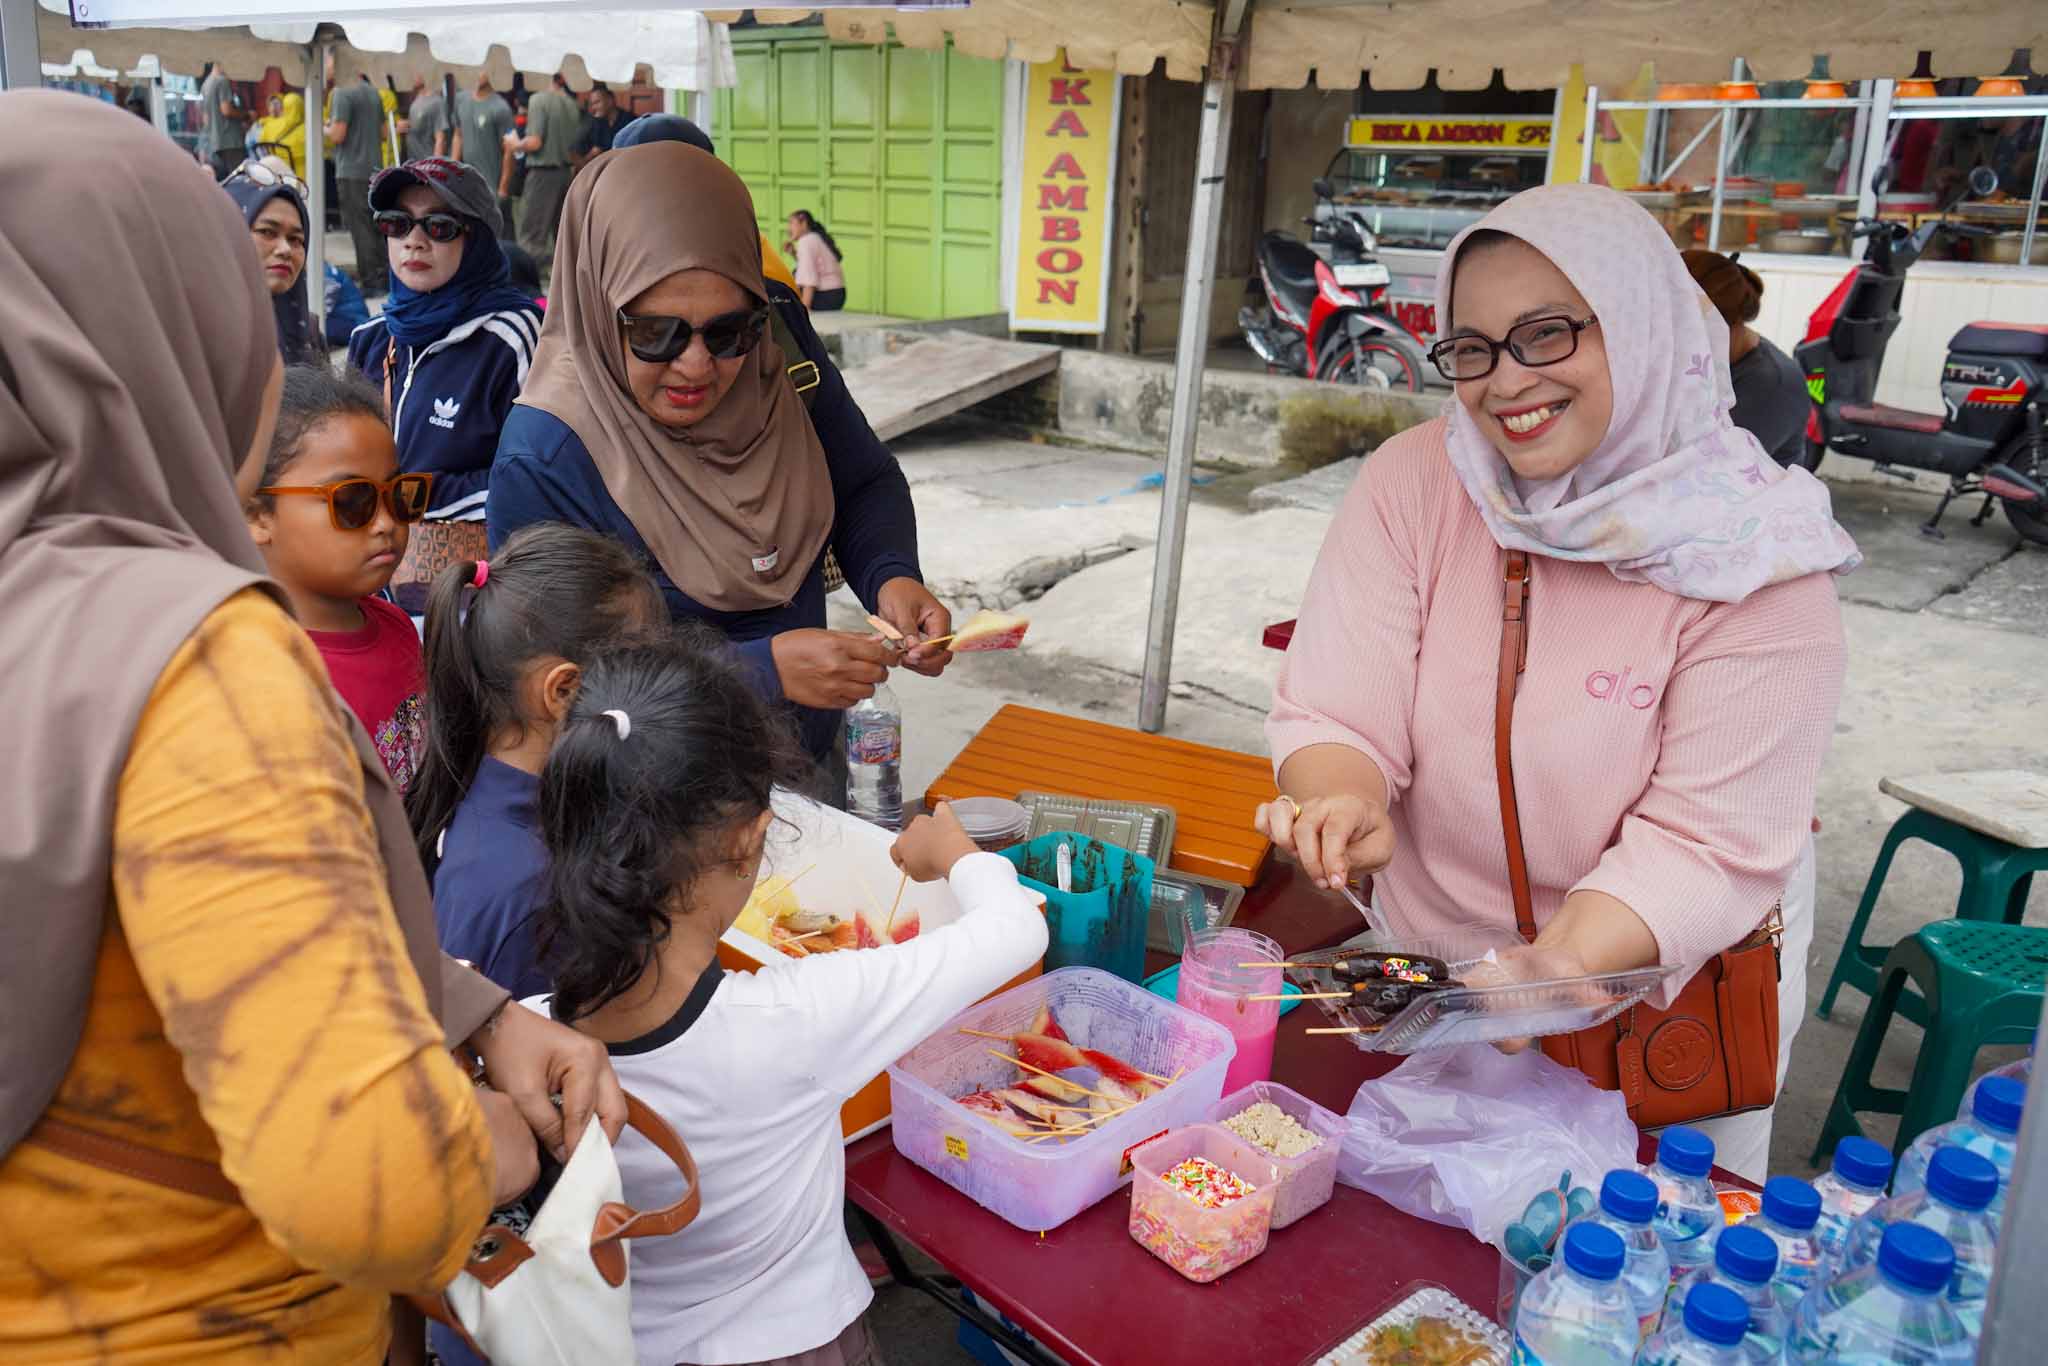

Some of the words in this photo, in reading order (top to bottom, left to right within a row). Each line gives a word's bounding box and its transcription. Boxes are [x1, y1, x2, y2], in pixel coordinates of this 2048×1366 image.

[1426, 123, 1505, 144] AMBON
[1036, 152, 1090, 306] AMBON
[429, 415, 455, 429] adidas
[1584, 664, 1658, 709] alo
